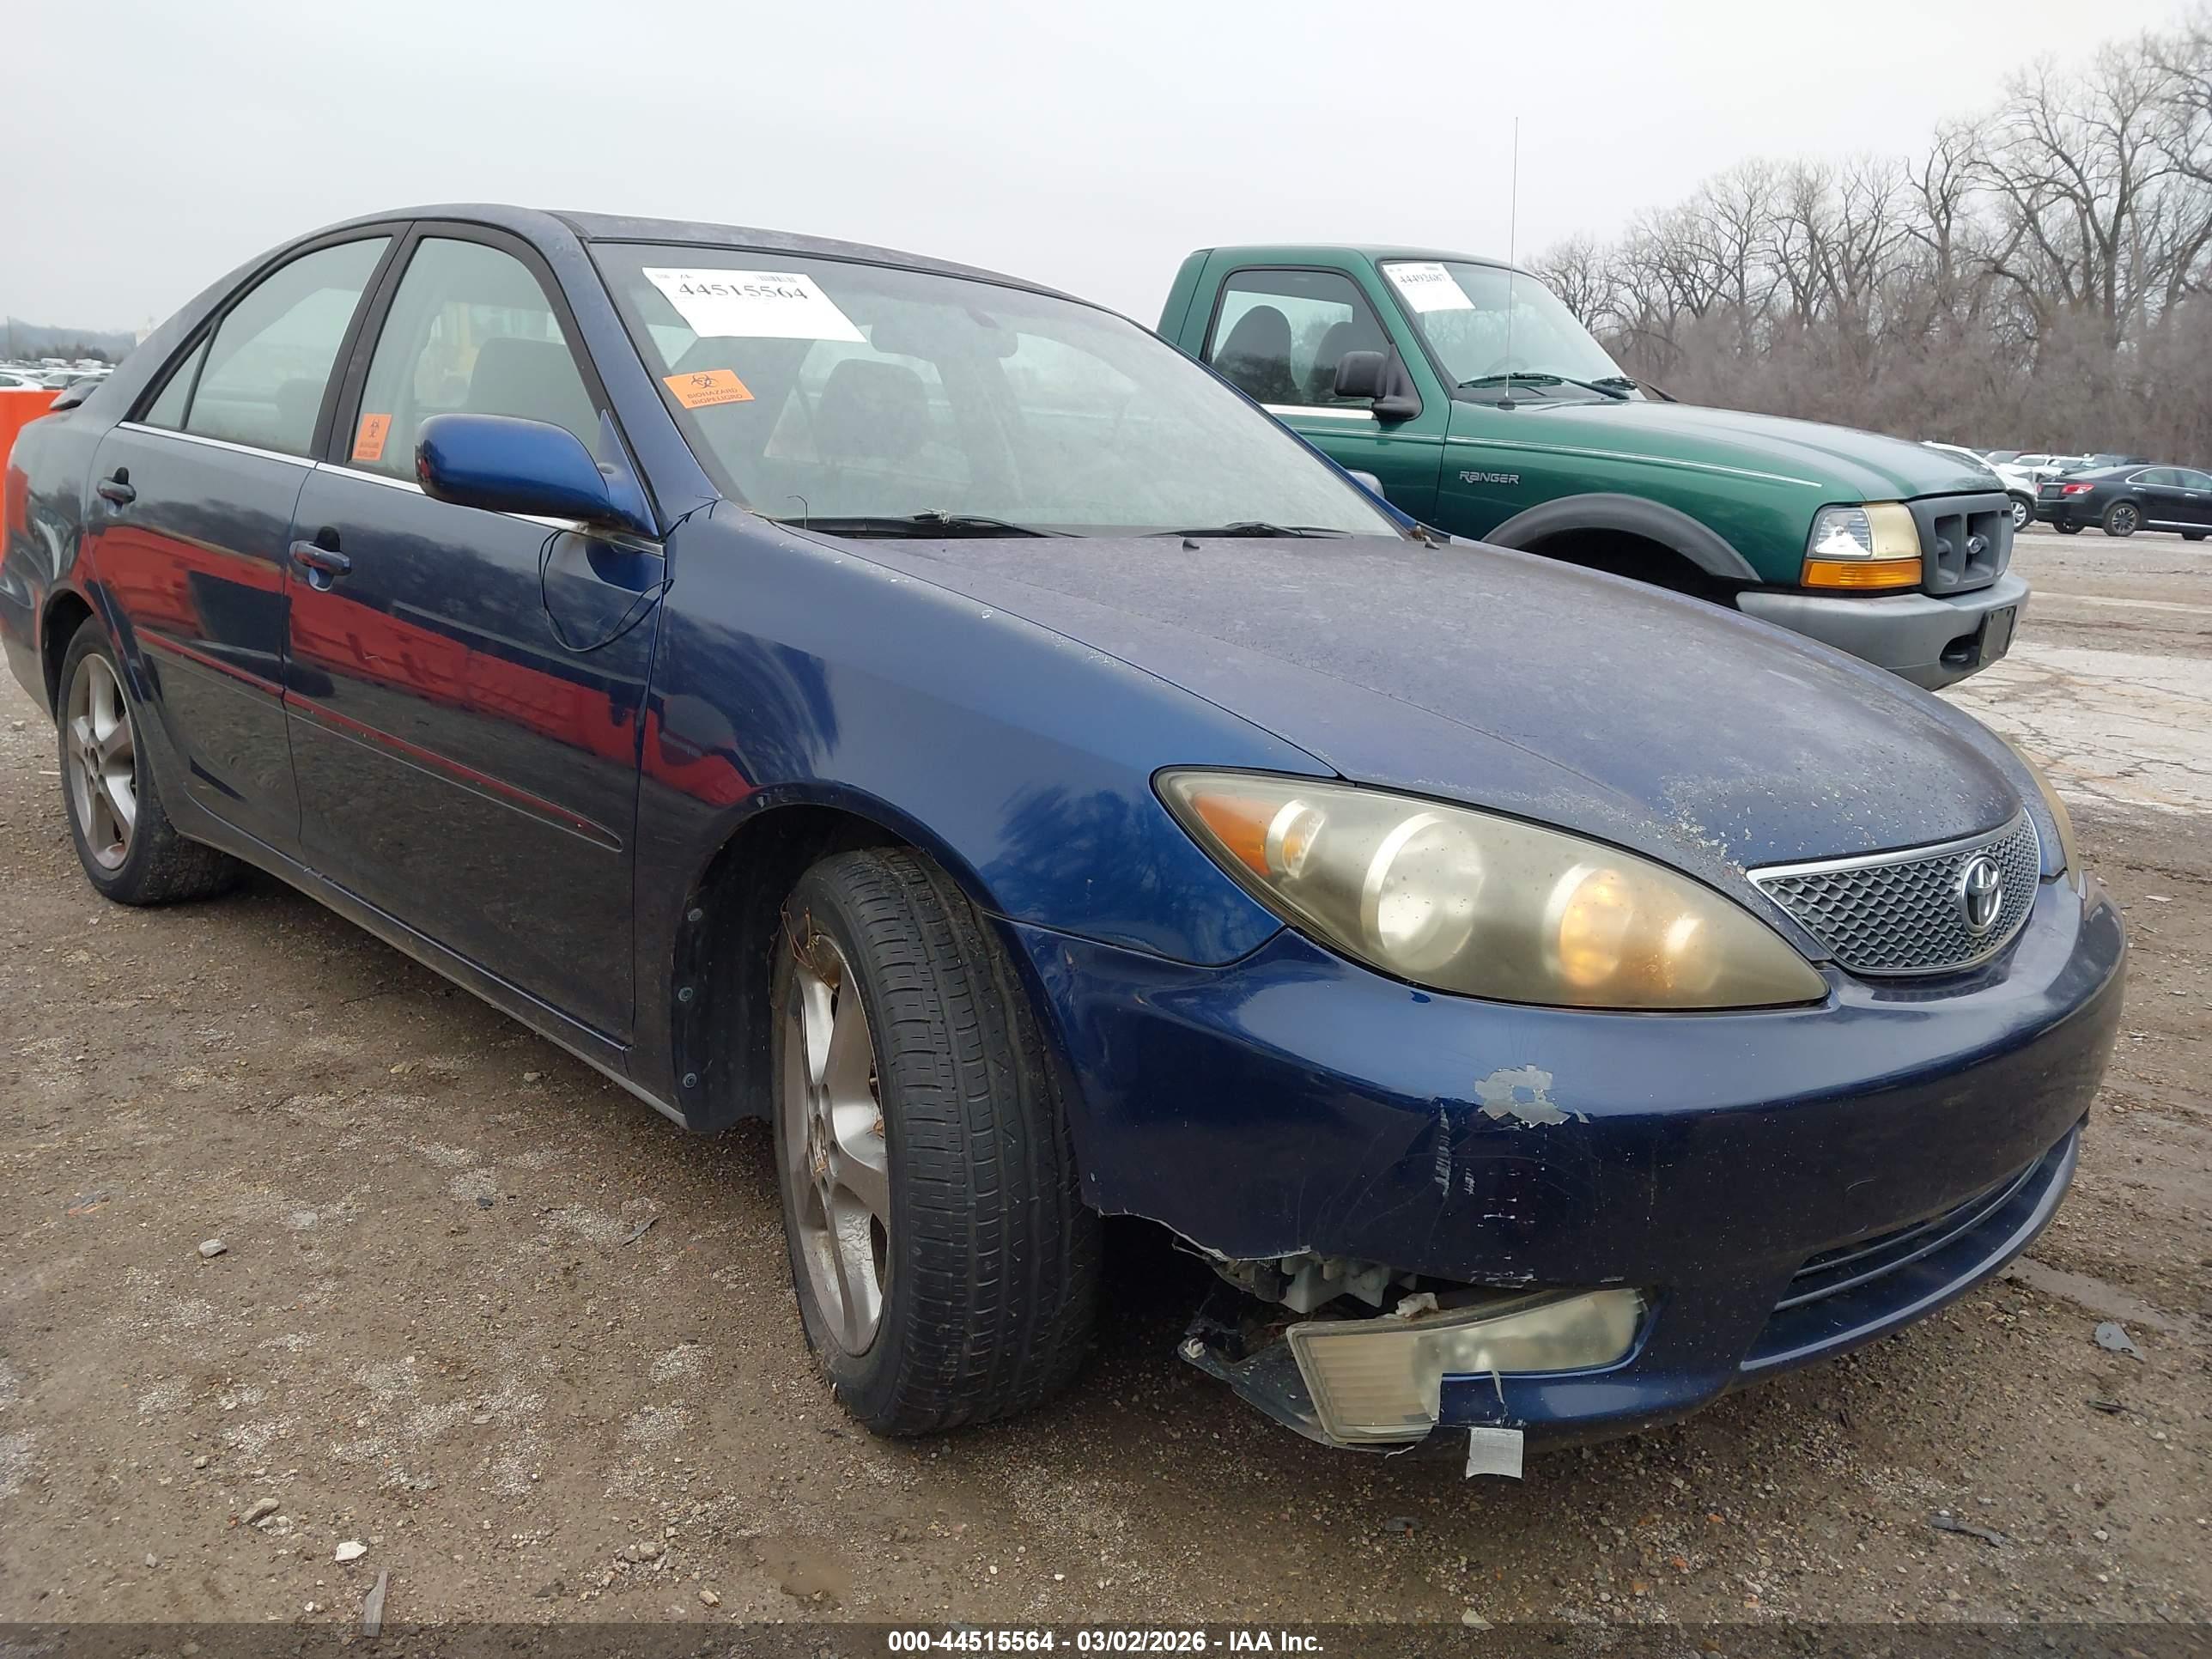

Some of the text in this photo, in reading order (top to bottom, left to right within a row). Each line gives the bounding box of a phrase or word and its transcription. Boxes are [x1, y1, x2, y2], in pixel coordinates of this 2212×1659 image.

[679, 283, 808, 300] 44515564
[687, 387, 738, 399] BIOHAZARD
[1460, 471, 1519, 485] RANGER
